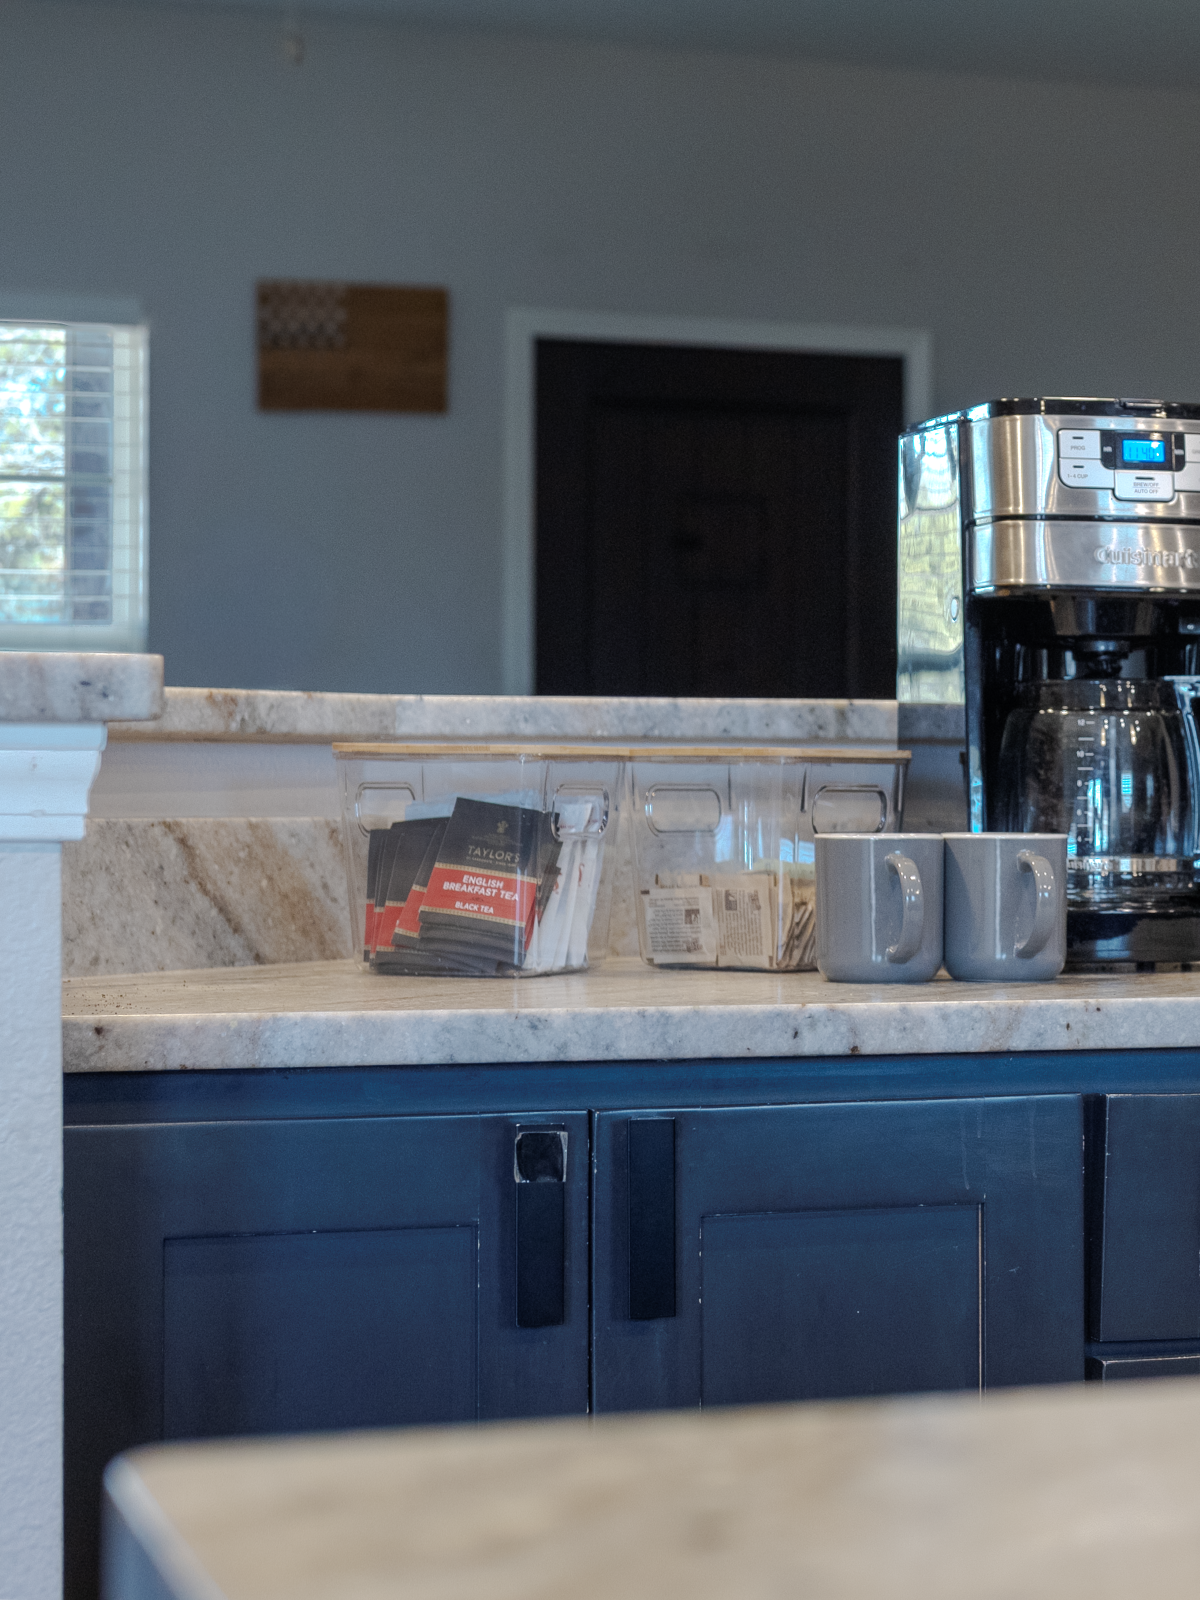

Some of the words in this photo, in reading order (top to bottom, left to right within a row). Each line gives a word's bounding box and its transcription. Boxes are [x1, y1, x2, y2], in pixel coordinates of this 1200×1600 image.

[1093, 545, 1198, 569] Cuisinart
[468, 845, 521, 863] TAYLOR'S
[462, 874, 504, 889] ENGLISH
[442, 881, 498, 897] BREAKFAST
[499, 889, 519, 902] TEA
[454, 901, 480, 911] BLACK
[480, 904, 494, 914] TEA
